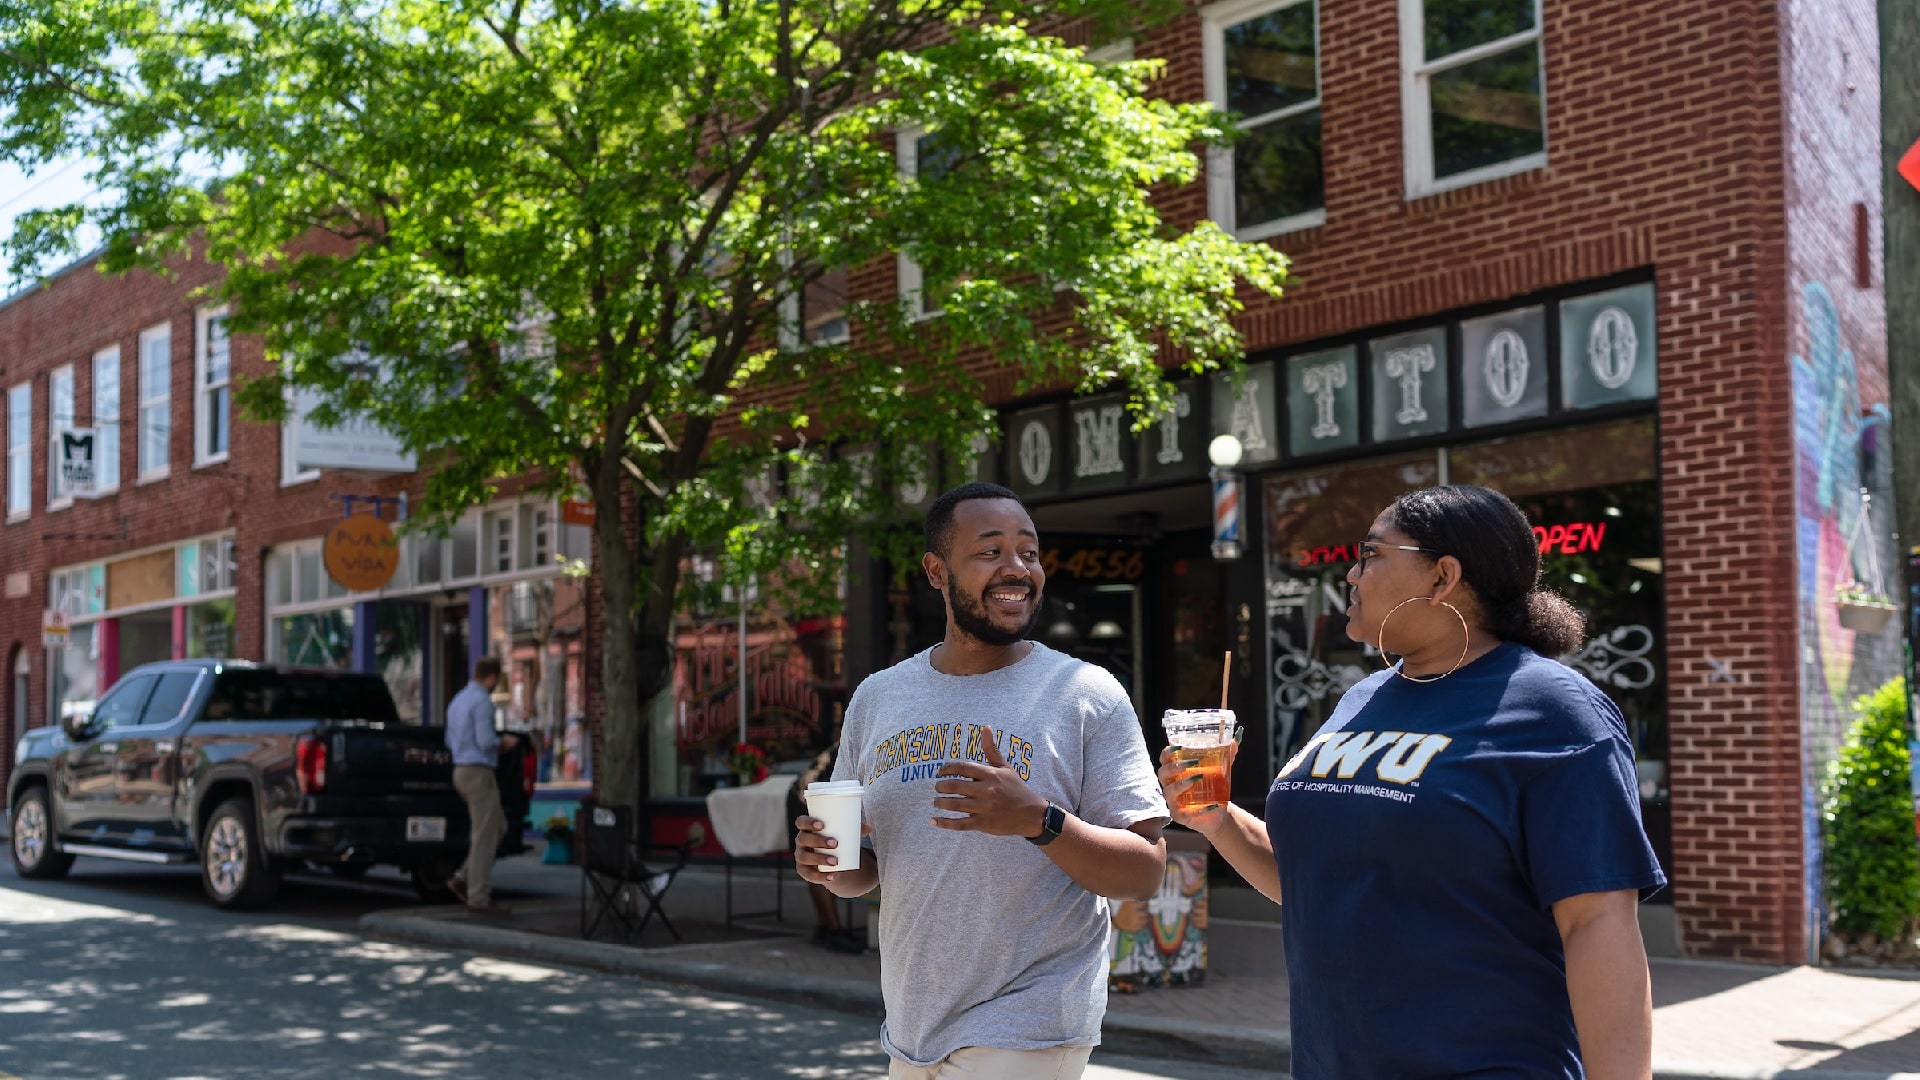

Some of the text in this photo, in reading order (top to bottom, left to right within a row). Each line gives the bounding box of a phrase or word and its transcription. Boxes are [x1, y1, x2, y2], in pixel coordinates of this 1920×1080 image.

[1156, 305, 1639, 466] TATTOO
[1532, 521, 1607, 555] OPEN
[868, 723, 950, 786] JOHNSON
[950, 723, 961, 759] &
[1276, 731, 1453, 785] JWU
[1291, 781, 1304, 791] OF
[1304, 781, 1354, 794] HOSPITALITY
[1354, 784, 1416, 804] MANAGEMENT
